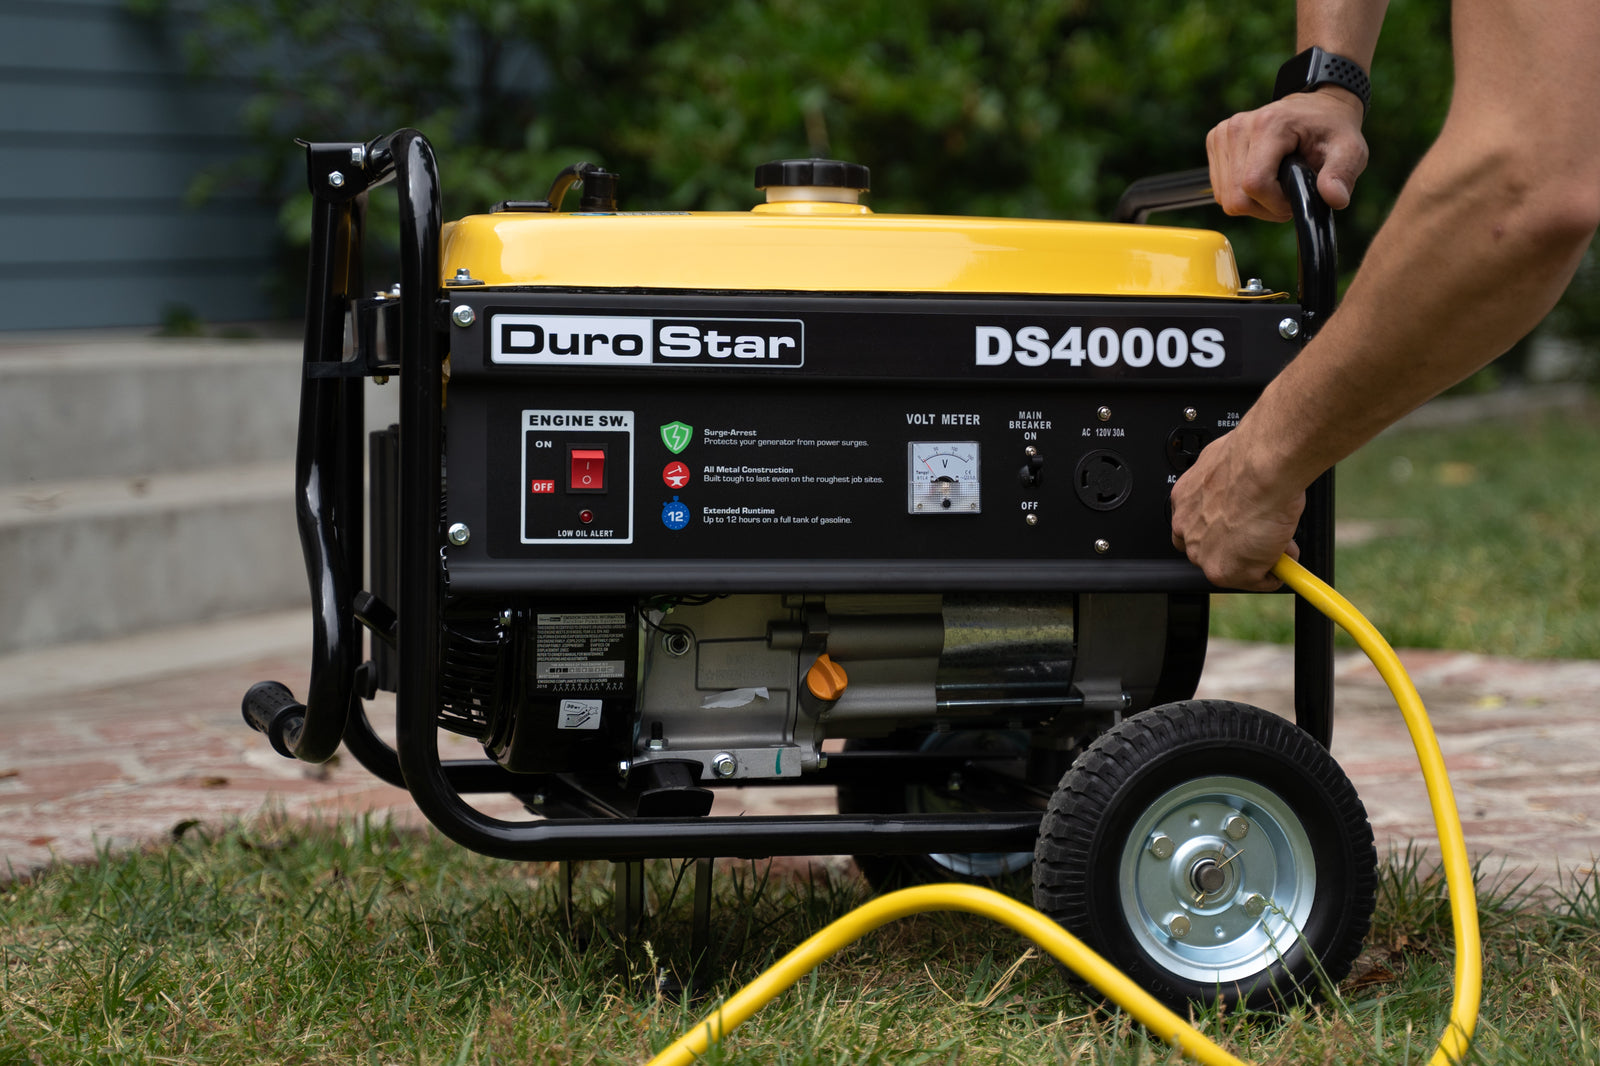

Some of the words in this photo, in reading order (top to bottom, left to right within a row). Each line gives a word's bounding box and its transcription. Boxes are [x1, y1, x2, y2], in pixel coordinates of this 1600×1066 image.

[501, 323, 643, 357] Duro
[659, 325, 796, 359] Star
[976, 326, 1225, 368] DS4000S
[906, 414, 936, 425] VOLT
[942, 414, 981, 426] METER
[1019, 411, 1042, 419] MAIN
[530, 414, 593, 427] ENGINE
[599, 415, 628, 427] SW.
[1009, 420, 1052, 430] BREAKER
[1217, 420, 1240, 428] BREAK
[703, 429, 757, 438] Surge-Arrest
[1024, 432, 1037, 441] ON
[1081, 428, 1091, 437] AC
[1096, 428, 1112, 437] 120V
[1112, 428, 1125, 437] 30A
[535, 440, 552, 449] ON
[703, 438, 737, 446] Protects
[757, 439, 796, 447] generator
[817, 440, 840, 448] power
[842, 440, 869, 448] surges.
[942, 459, 948, 469] V
[704, 465, 715, 474] All
[716, 465, 740, 474] Metal
[741, 465, 794, 474] Construction
[722, 475, 745, 484] tough
[755, 475, 771, 483] last
[816, 476, 851, 485] roughest
[851, 476, 863, 485] job
[863, 476, 884, 484] sites.
[1167, 475, 1177, 484] AC
[533, 482, 553, 492] OFF
[703, 506, 740, 515] Extended
[741, 507, 775, 515] Runtime
[1021, 501, 1039, 511] OFF
[667, 511, 684, 523] 12
[703, 515, 714, 525] Up
[726, 515, 737, 523] 12
[792, 516, 810, 524] tank
[810, 516, 819, 524] of
[820, 516, 853, 526] gasoline.
[558, 529, 573, 538] LOW
[576, 529, 588, 538] OIL
[590, 529, 614, 538] ALERT
